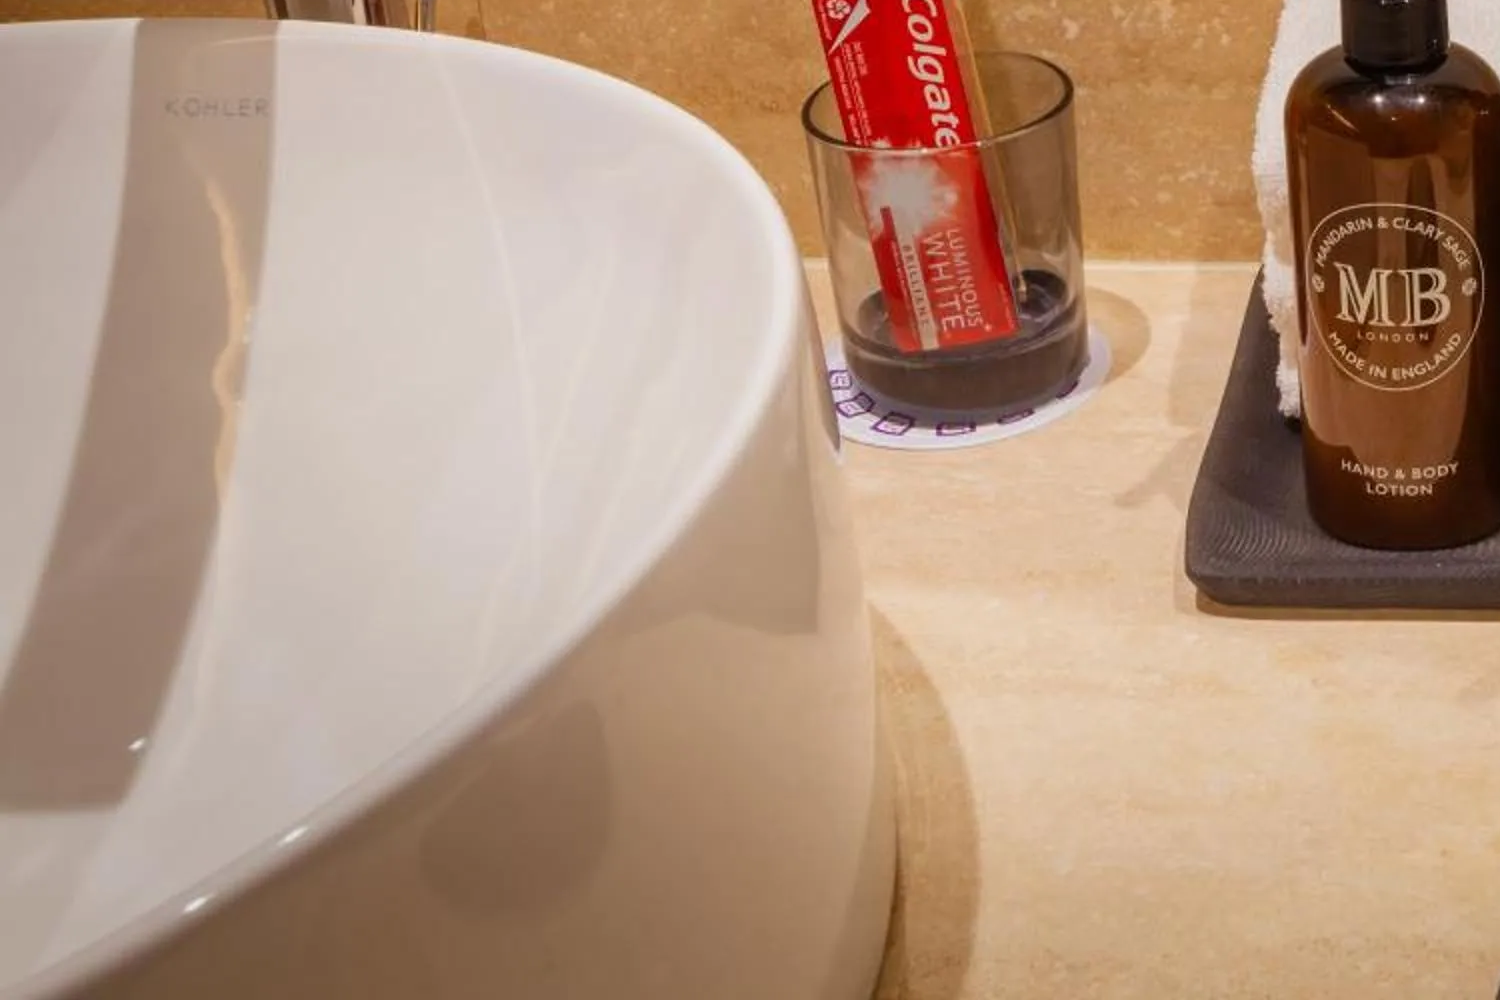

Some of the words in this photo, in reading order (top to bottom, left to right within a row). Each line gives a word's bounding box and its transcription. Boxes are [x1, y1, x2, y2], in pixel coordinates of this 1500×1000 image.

[165, 97, 269, 118] KOHLER
[1316, 216, 1373, 268] MANDARIN
[1377, 215, 1389, 230] &
[1392, 217, 1444, 243] CLARY
[1442, 234, 1473, 270] SAGE
[924, 231, 967, 330] WHITE
[946, 228, 985, 328] LUMINOUS
[1334, 261, 1451, 328] MB
[1328, 330, 1365, 372] MADE
[1368, 361, 1387, 380] IN
[1392, 331, 1463, 381] ENGLAND
[1356, 331, 1430, 342] LONDON
[1341, 458, 1389, 479] HAND
[1394, 467, 1407, 480] &
[1411, 461, 1460, 480] BODY
[1366, 483, 1434, 497] LOTION
